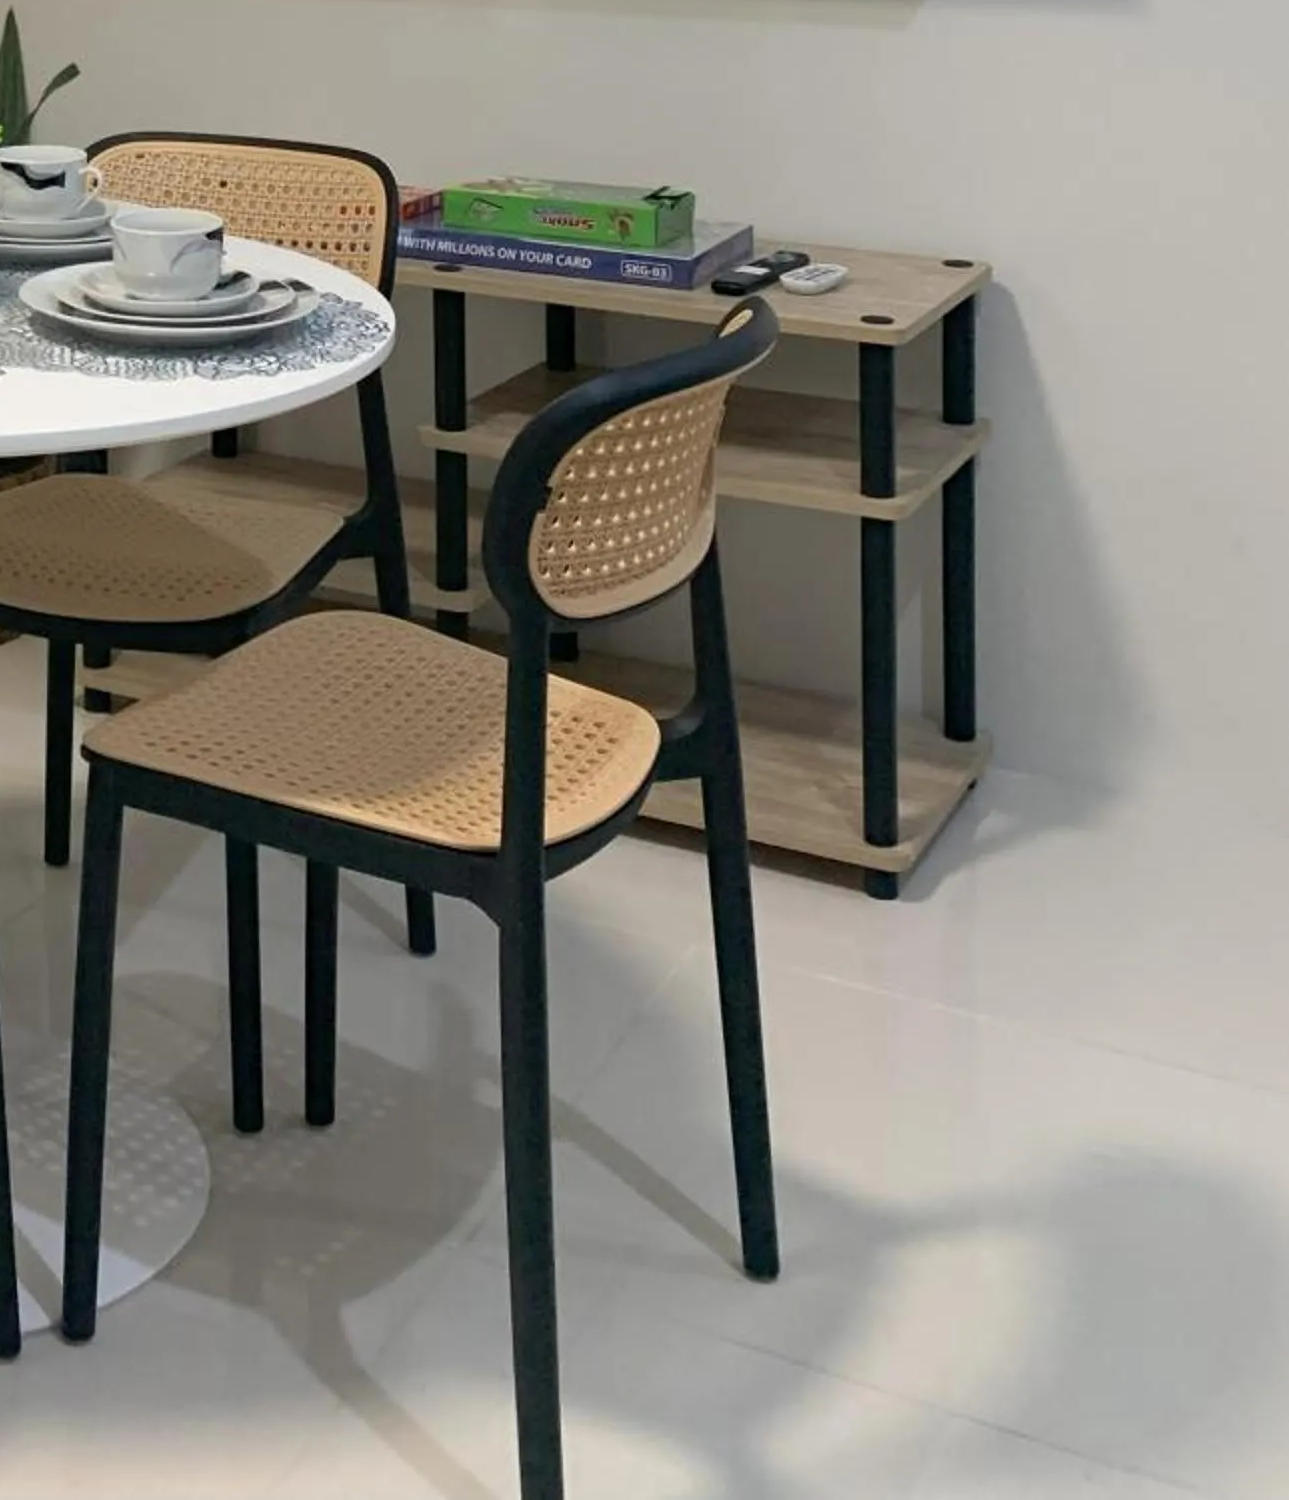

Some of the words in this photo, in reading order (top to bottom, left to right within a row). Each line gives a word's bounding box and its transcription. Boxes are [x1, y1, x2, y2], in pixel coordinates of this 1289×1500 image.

[437, 239, 495, 258] MILLIONS
[497, 246, 515, 261] ON
[519, 248, 553, 266] YOUR
[556, 254, 592, 269] CARD
